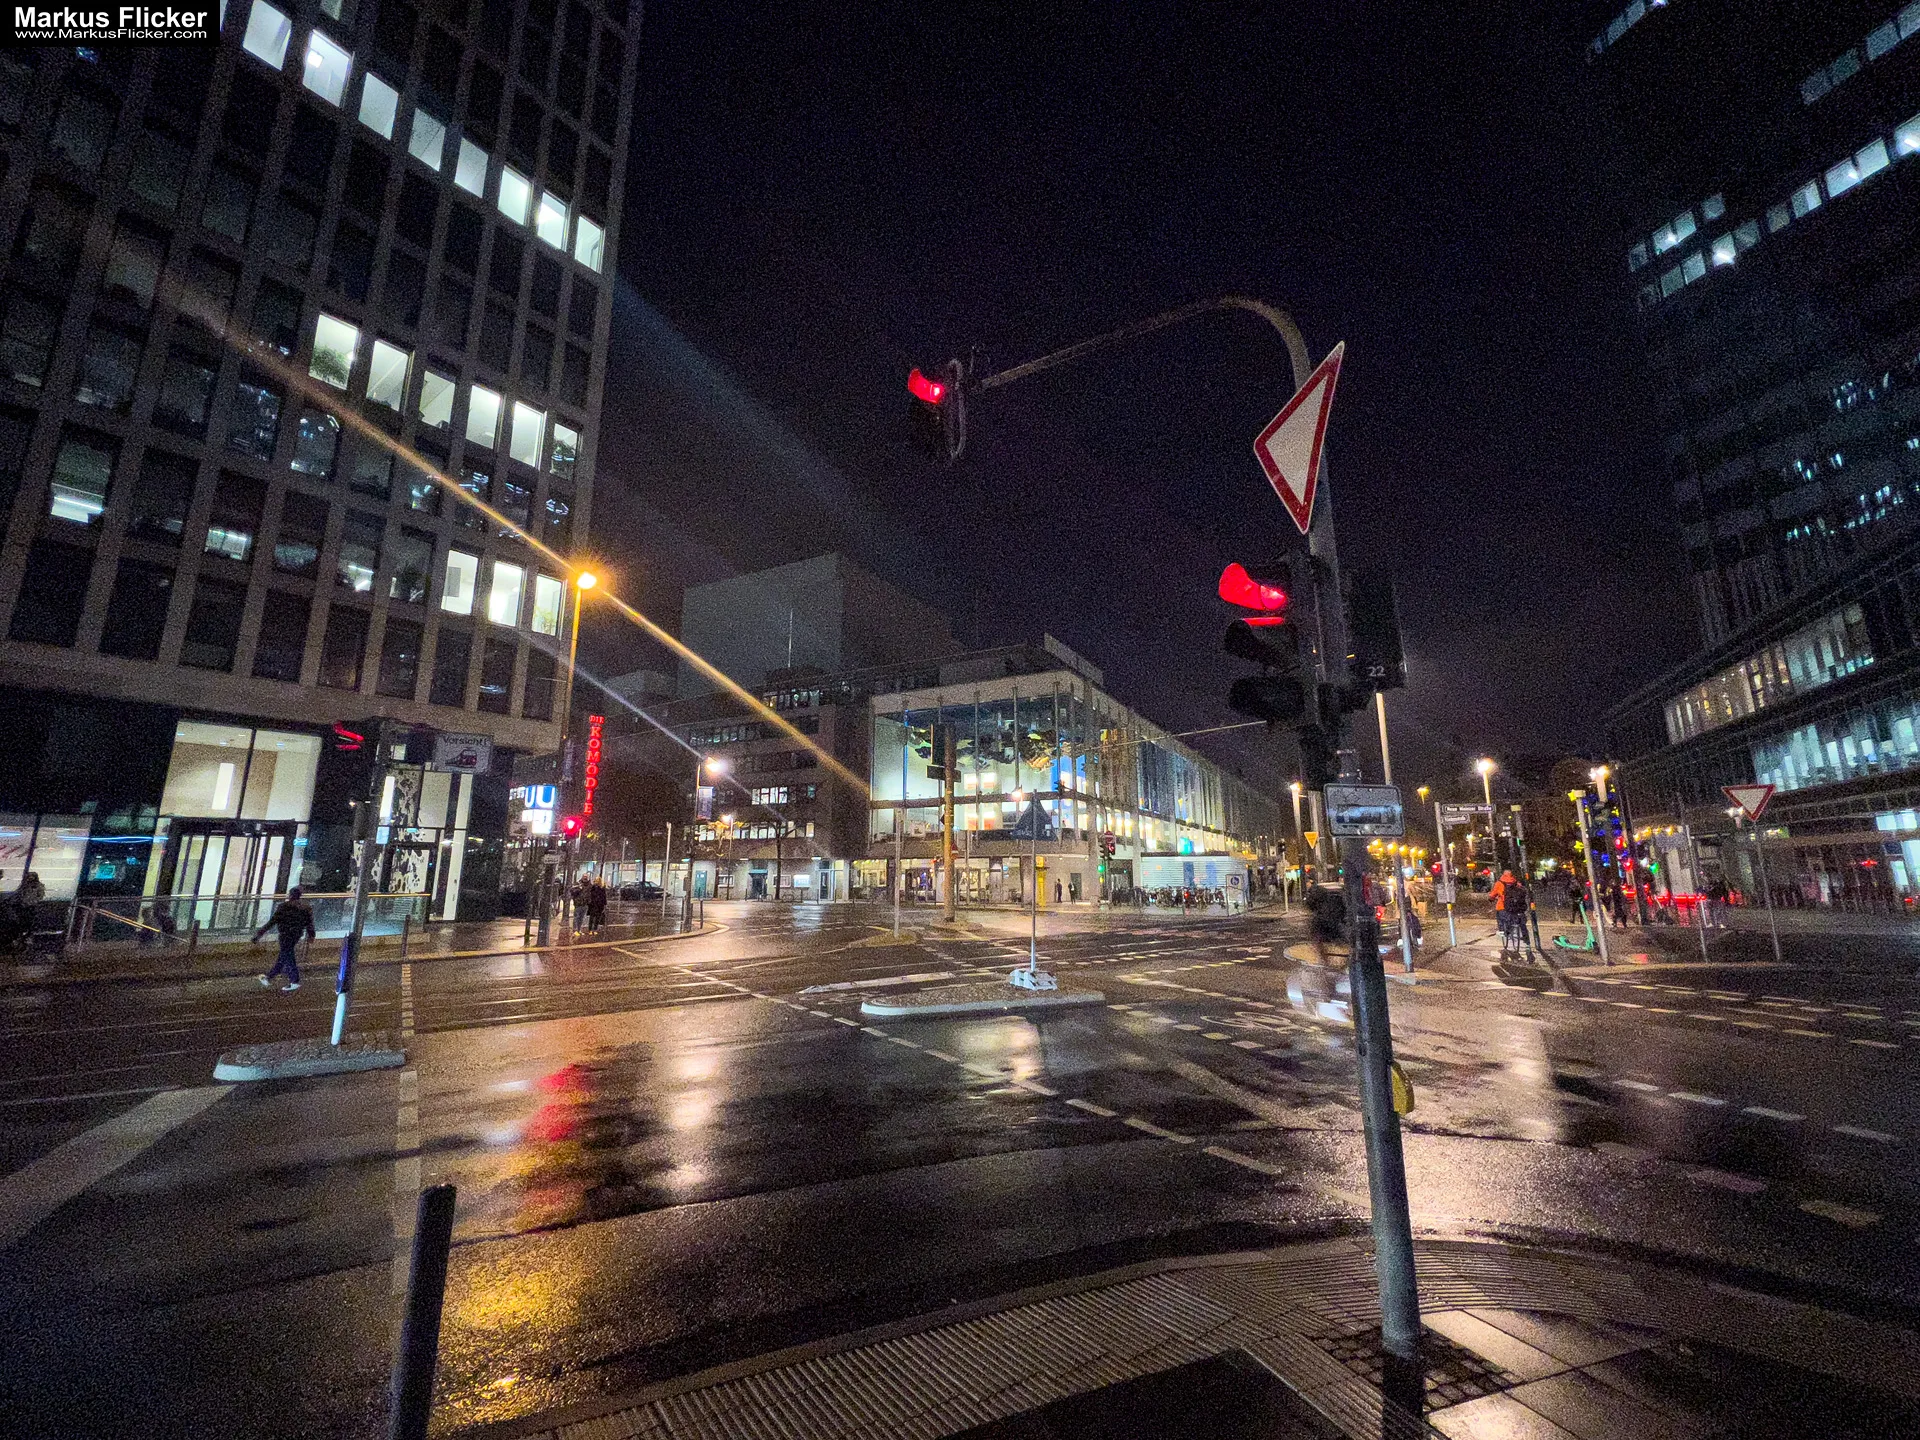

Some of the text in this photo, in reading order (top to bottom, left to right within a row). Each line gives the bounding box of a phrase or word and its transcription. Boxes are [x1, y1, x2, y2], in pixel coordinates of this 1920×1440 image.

[1368, 665, 1386, 677] 22
[589, 714, 605, 725] DIE
[584, 726, 602, 815] KOMÖDIE
[536, 785, 556, 808] U
